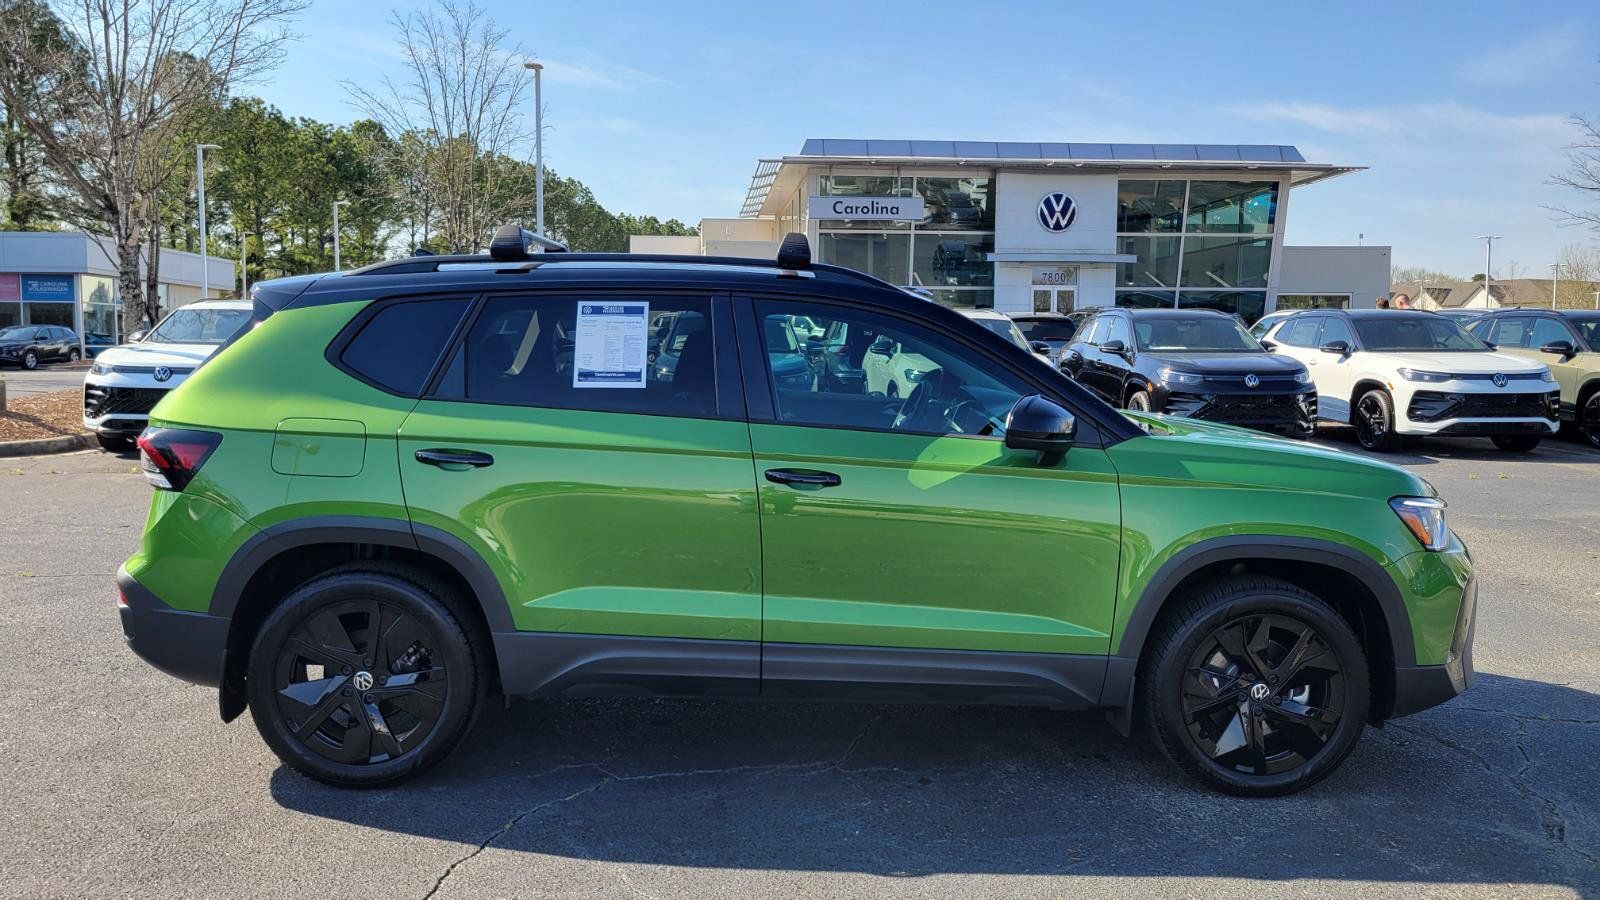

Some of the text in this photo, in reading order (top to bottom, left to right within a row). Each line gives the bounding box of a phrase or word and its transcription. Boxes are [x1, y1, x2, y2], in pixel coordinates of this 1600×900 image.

[832, 200, 900, 215] Carolina
[1039, 192, 1076, 231] VW
[1041, 272, 1066, 283] 7800
